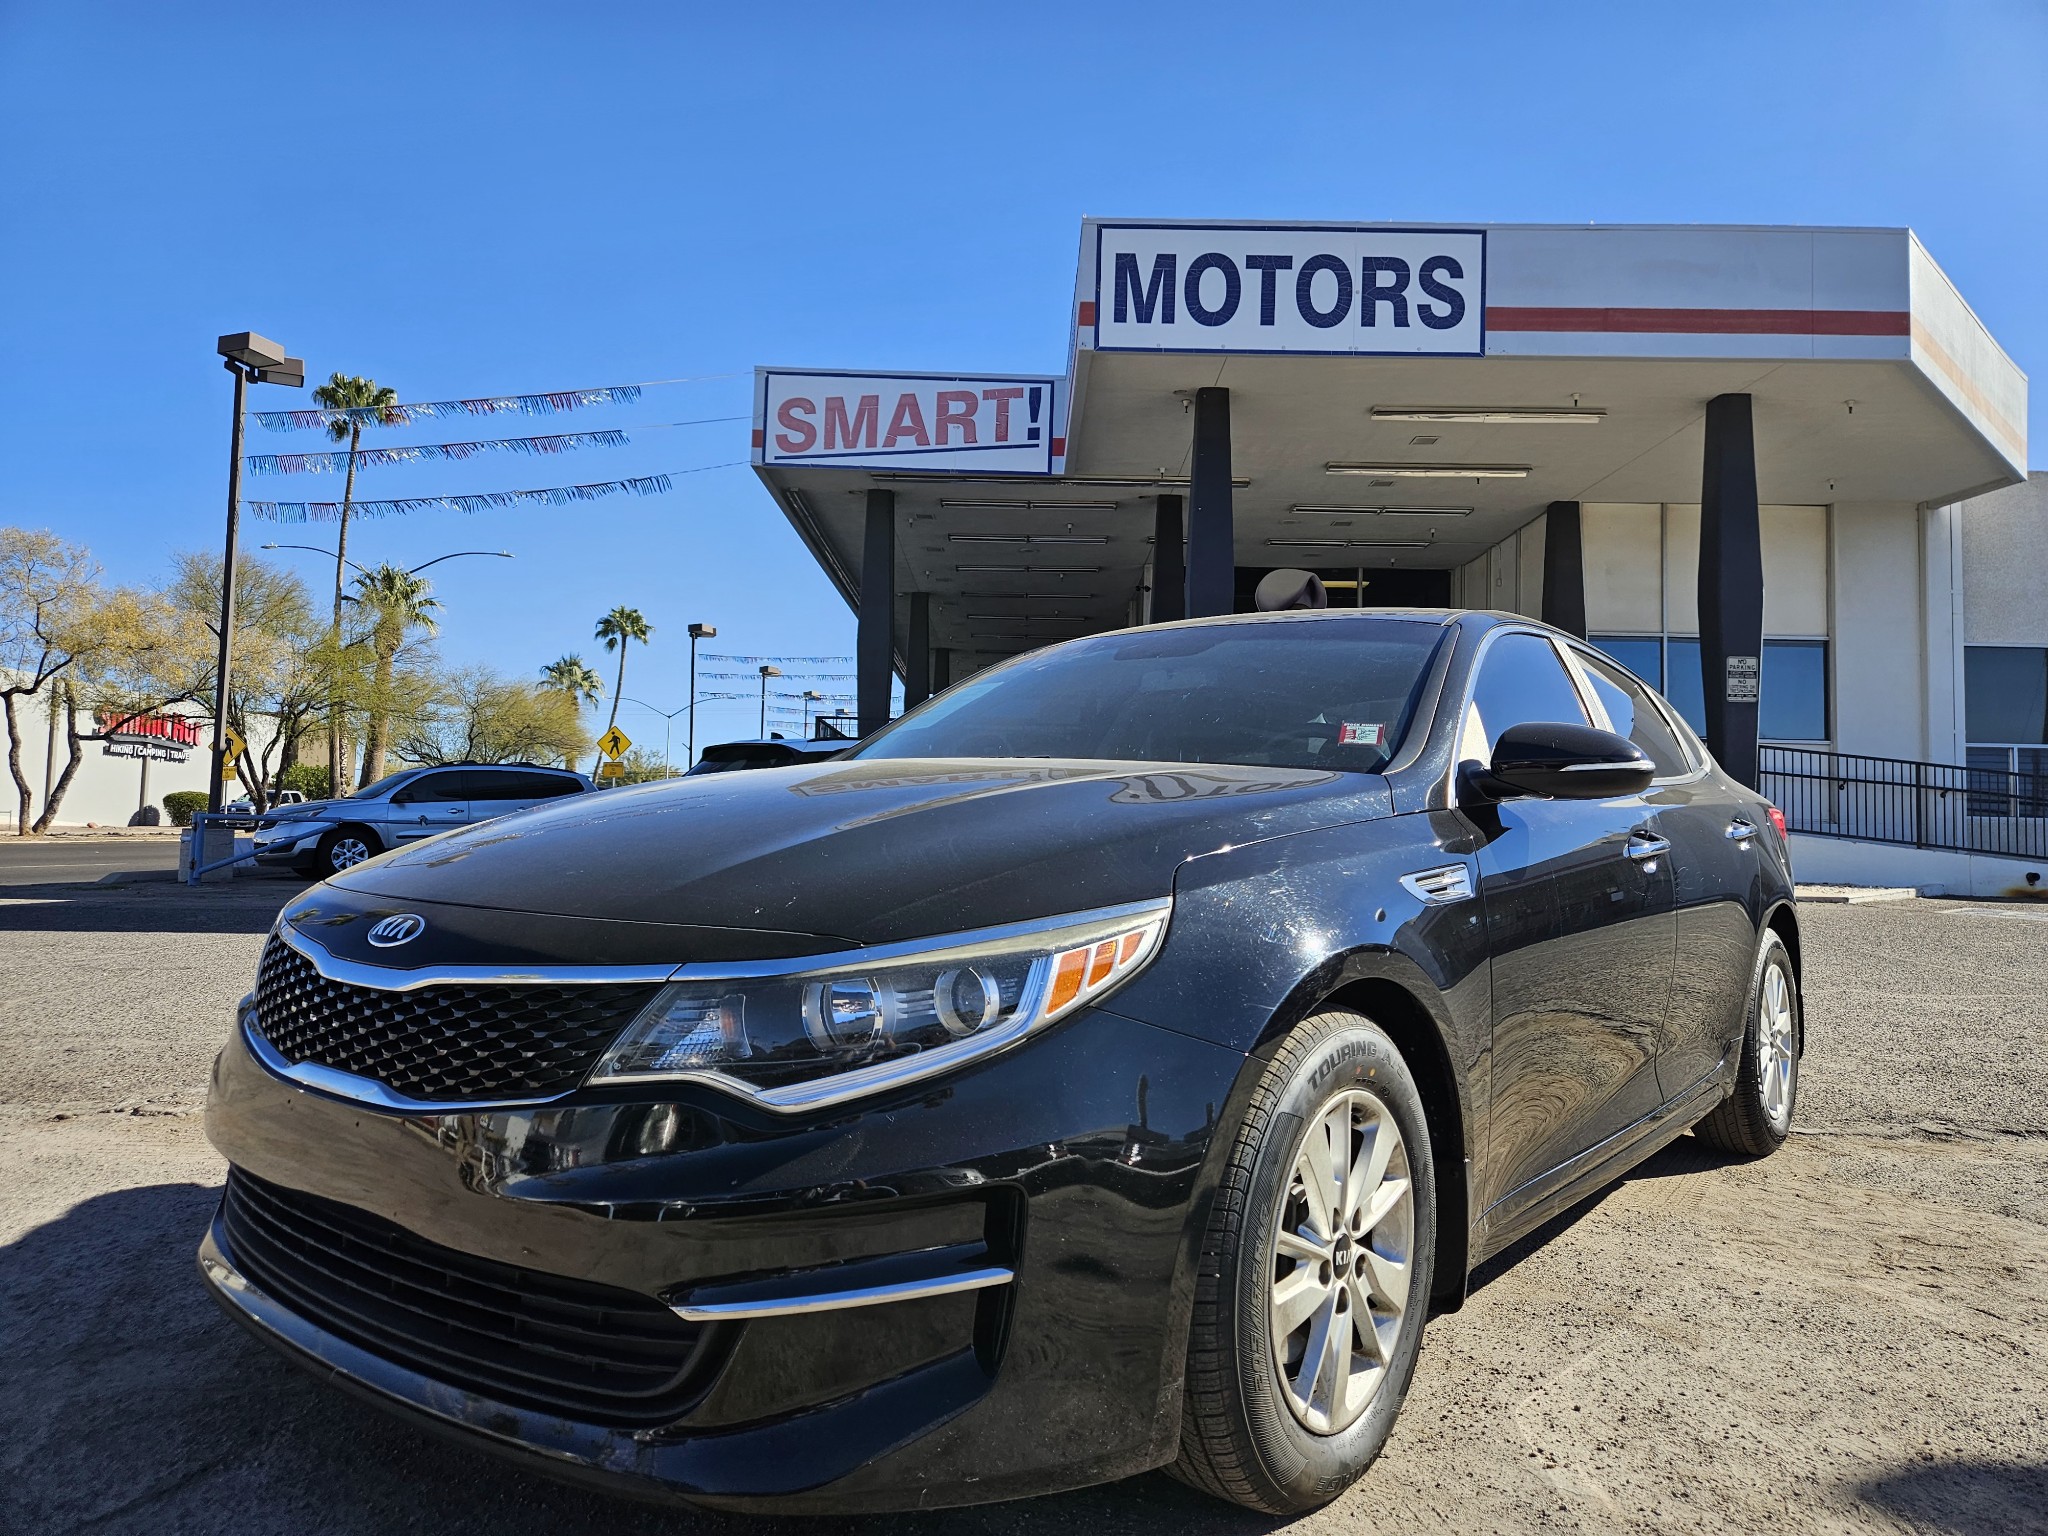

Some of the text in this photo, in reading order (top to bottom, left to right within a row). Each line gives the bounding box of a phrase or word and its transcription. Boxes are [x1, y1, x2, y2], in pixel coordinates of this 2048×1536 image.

[1113, 252, 1466, 330] MOTORS
[775, 386, 1042, 453] SMART!
[110, 744, 133, 755] HIKING
[137, 745, 167, 758] CAMPING
[371, 917, 415, 939] KIA
[1306, 1040, 1377, 1092] TOURING
[1335, 1249, 1351, 1266] KIA
